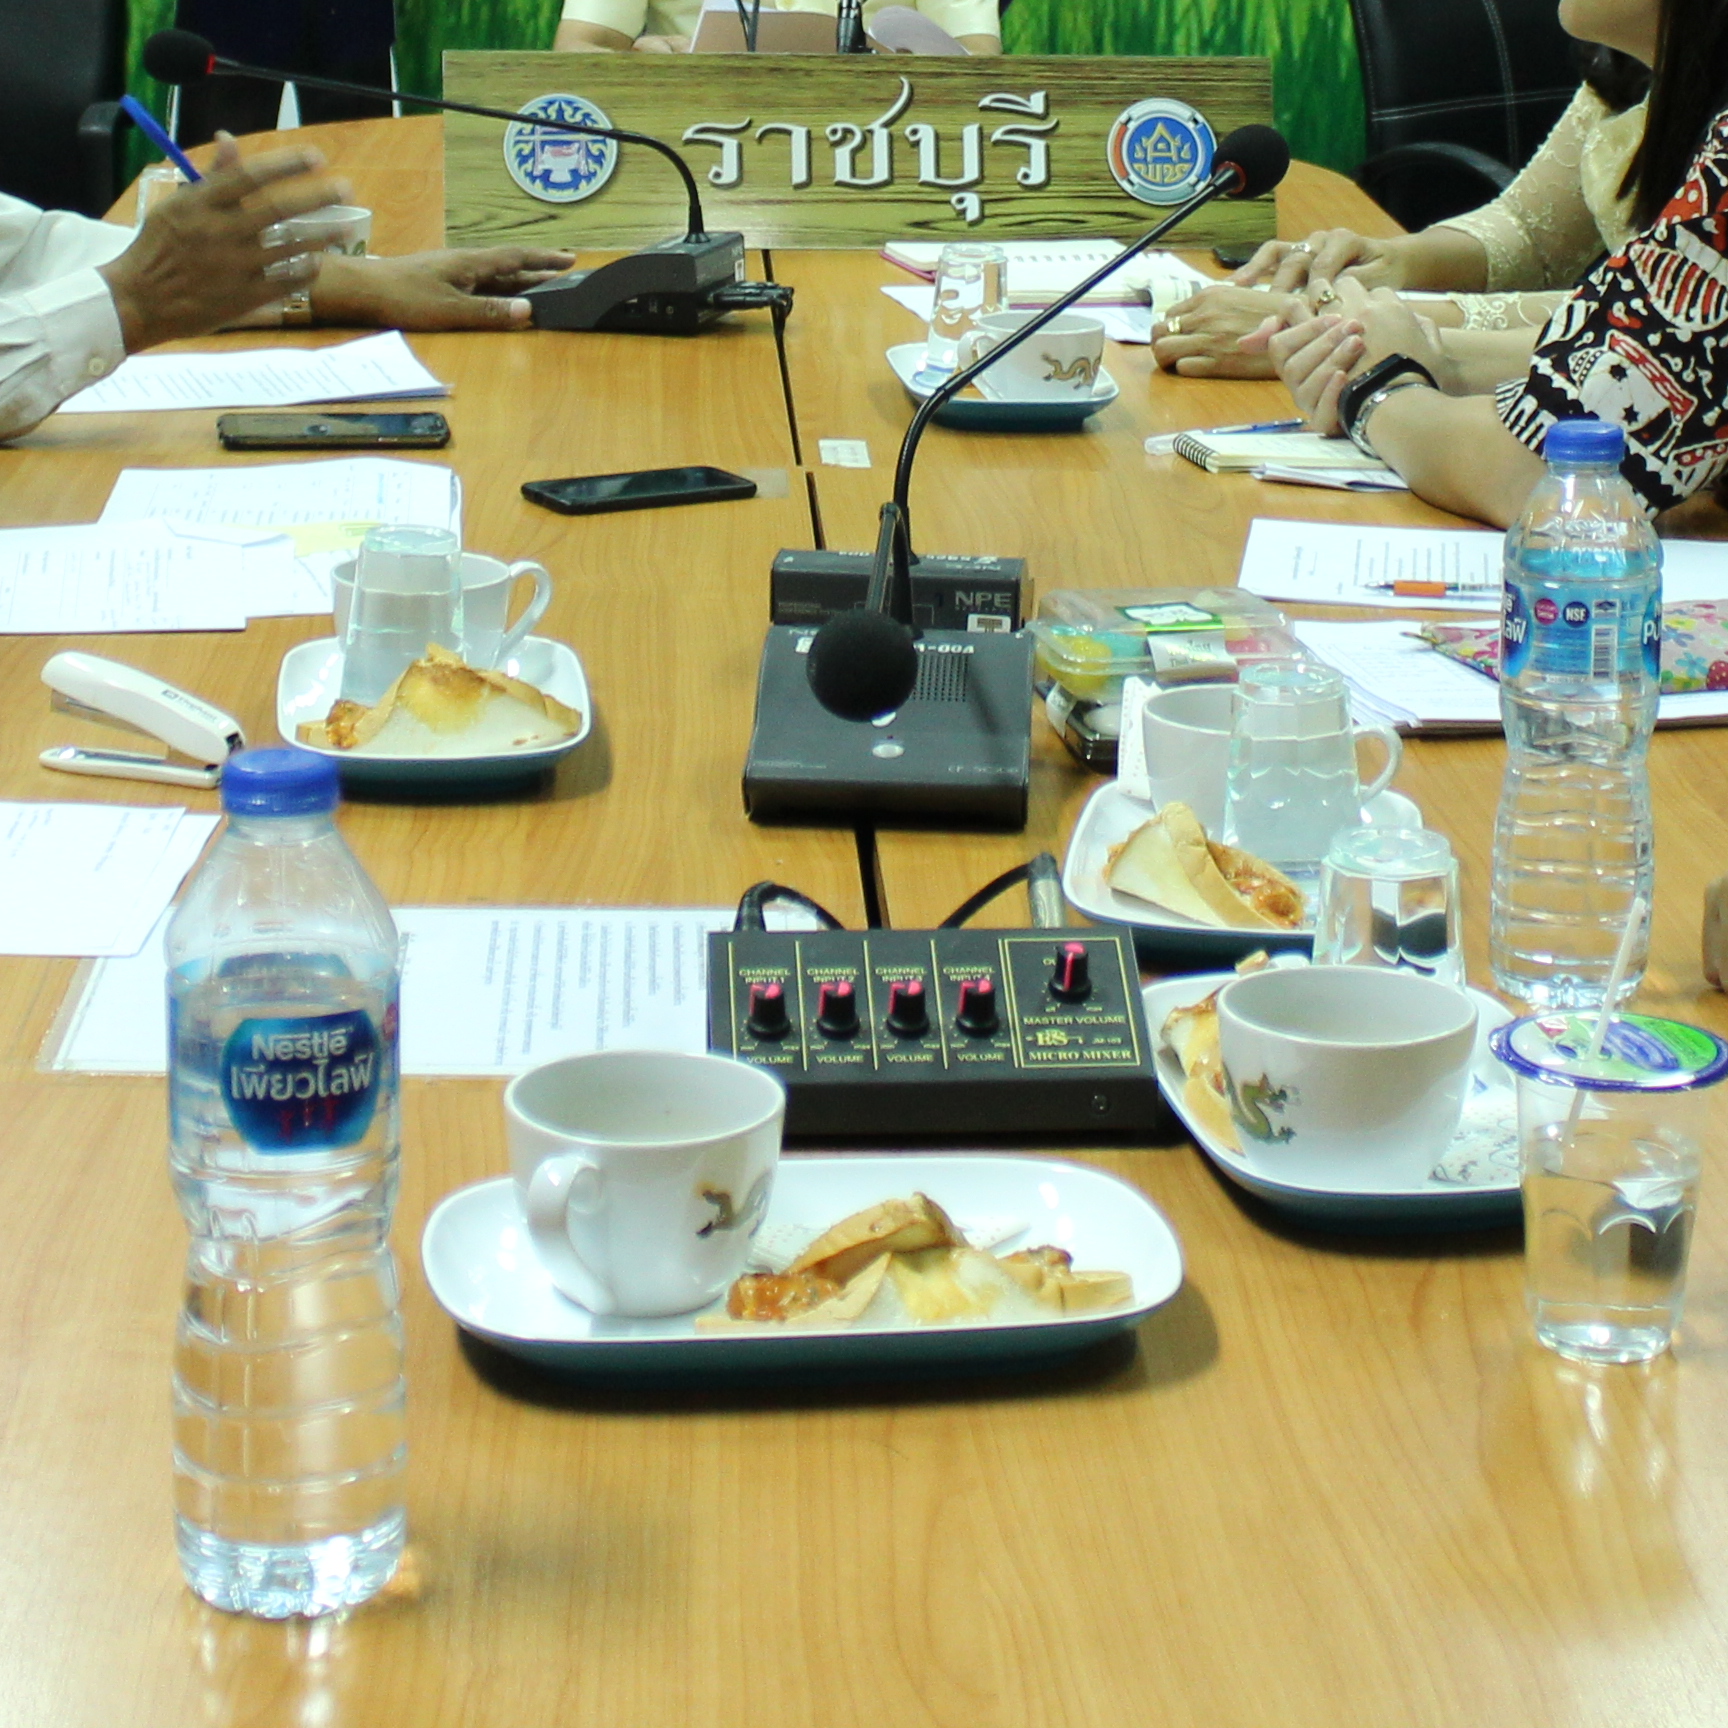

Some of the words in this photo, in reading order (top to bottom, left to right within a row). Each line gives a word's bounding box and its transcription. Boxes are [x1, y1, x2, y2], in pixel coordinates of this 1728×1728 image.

[681, 76, 1061, 224] ราชบุรี
[954, 590, 1012, 609] NPE
[739, 968, 790, 977] CHANNEL
[807, 968, 859, 976] CHANNEL
[875, 967, 926, 975] CHANNEL
[943, 966, 994, 974] CHANNEL
[1023, 1015, 1072, 1025] MASTER
[1075, 1015, 1125, 1024] VOLUME
[747, 1056, 794, 1064] VOLUME
[816, 1055, 864, 1063] VOLUME
[886, 1054, 934, 1063] VOLUME
[957, 1053, 1005, 1062] VOLUME
[1029, 1051, 1079, 1061] MICRO
[1083, 1050, 1132, 1060] MIXER
[229, 1051, 375, 1102] เพียวไลฟ์
